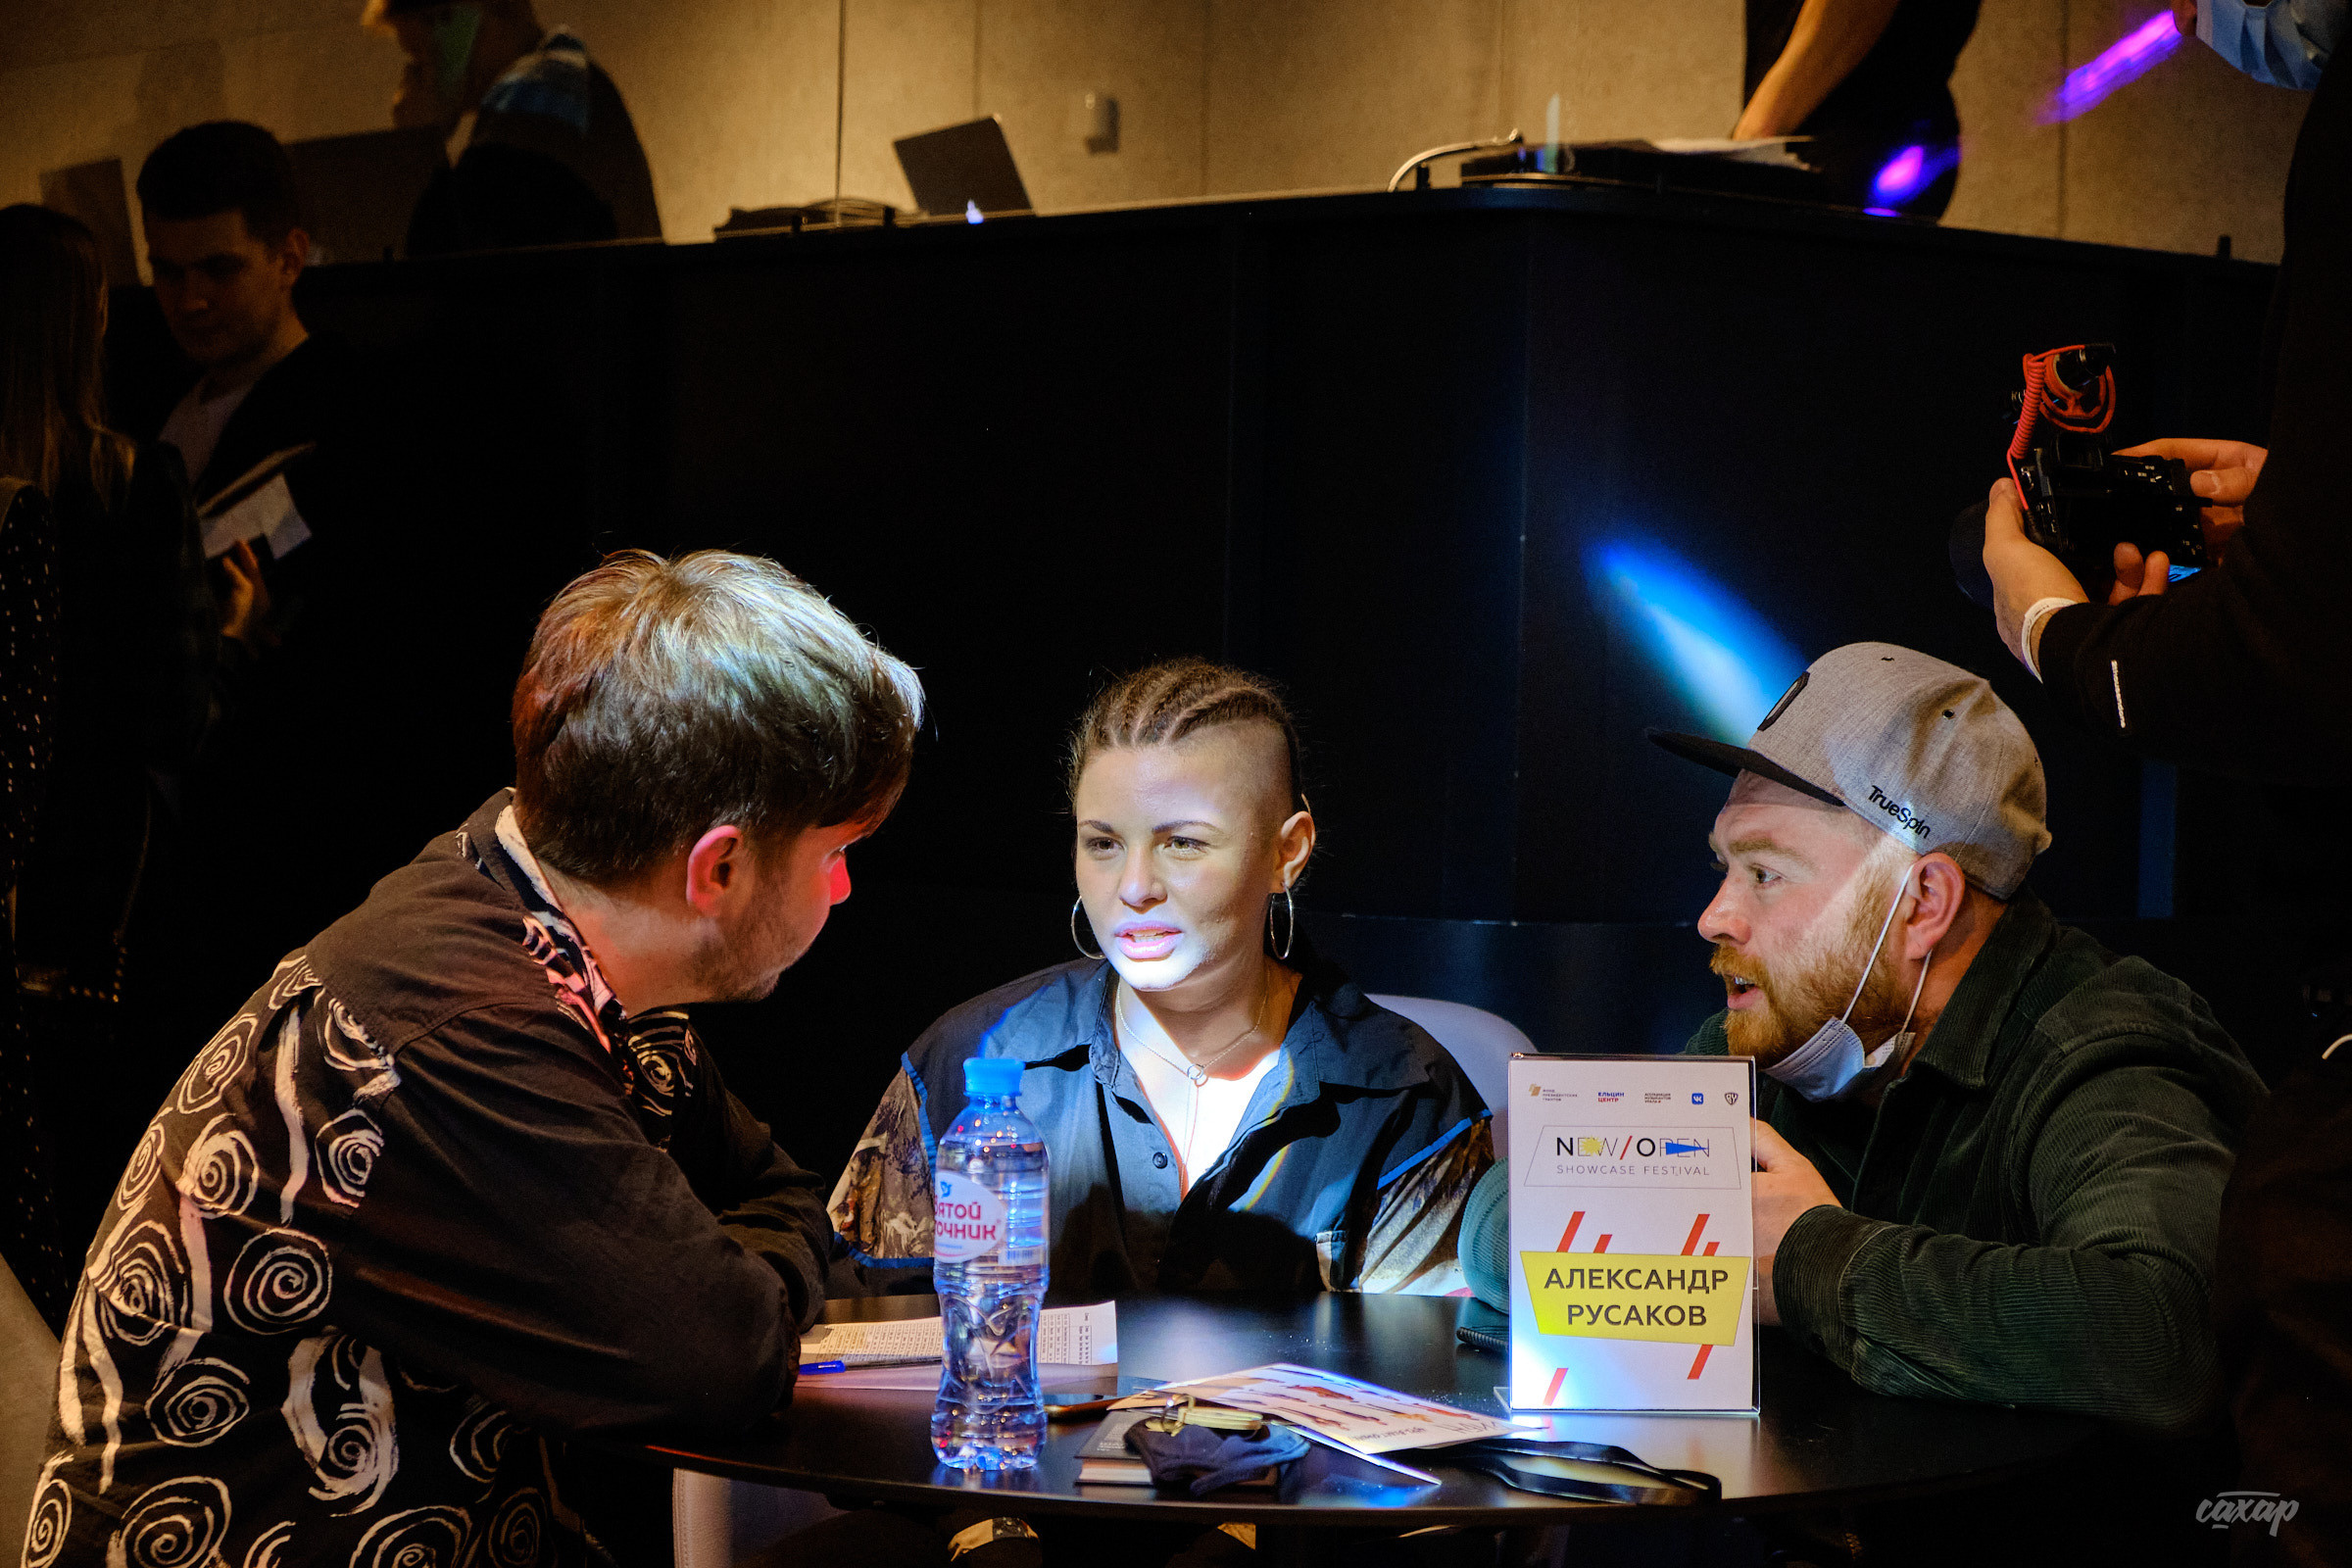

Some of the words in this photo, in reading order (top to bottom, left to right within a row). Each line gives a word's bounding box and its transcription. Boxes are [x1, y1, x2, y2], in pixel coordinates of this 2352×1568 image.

[1868, 785, 1931, 839] TrueSpin
[1556, 1164, 1636, 1175] SHOWCASE
[1643, 1165, 1710, 1176] FESTIVAL
[1544, 1268, 1729, 1294] АЛЕКСАНДР
[1568, 1304, 1707, 1326] РУСАКОВ
